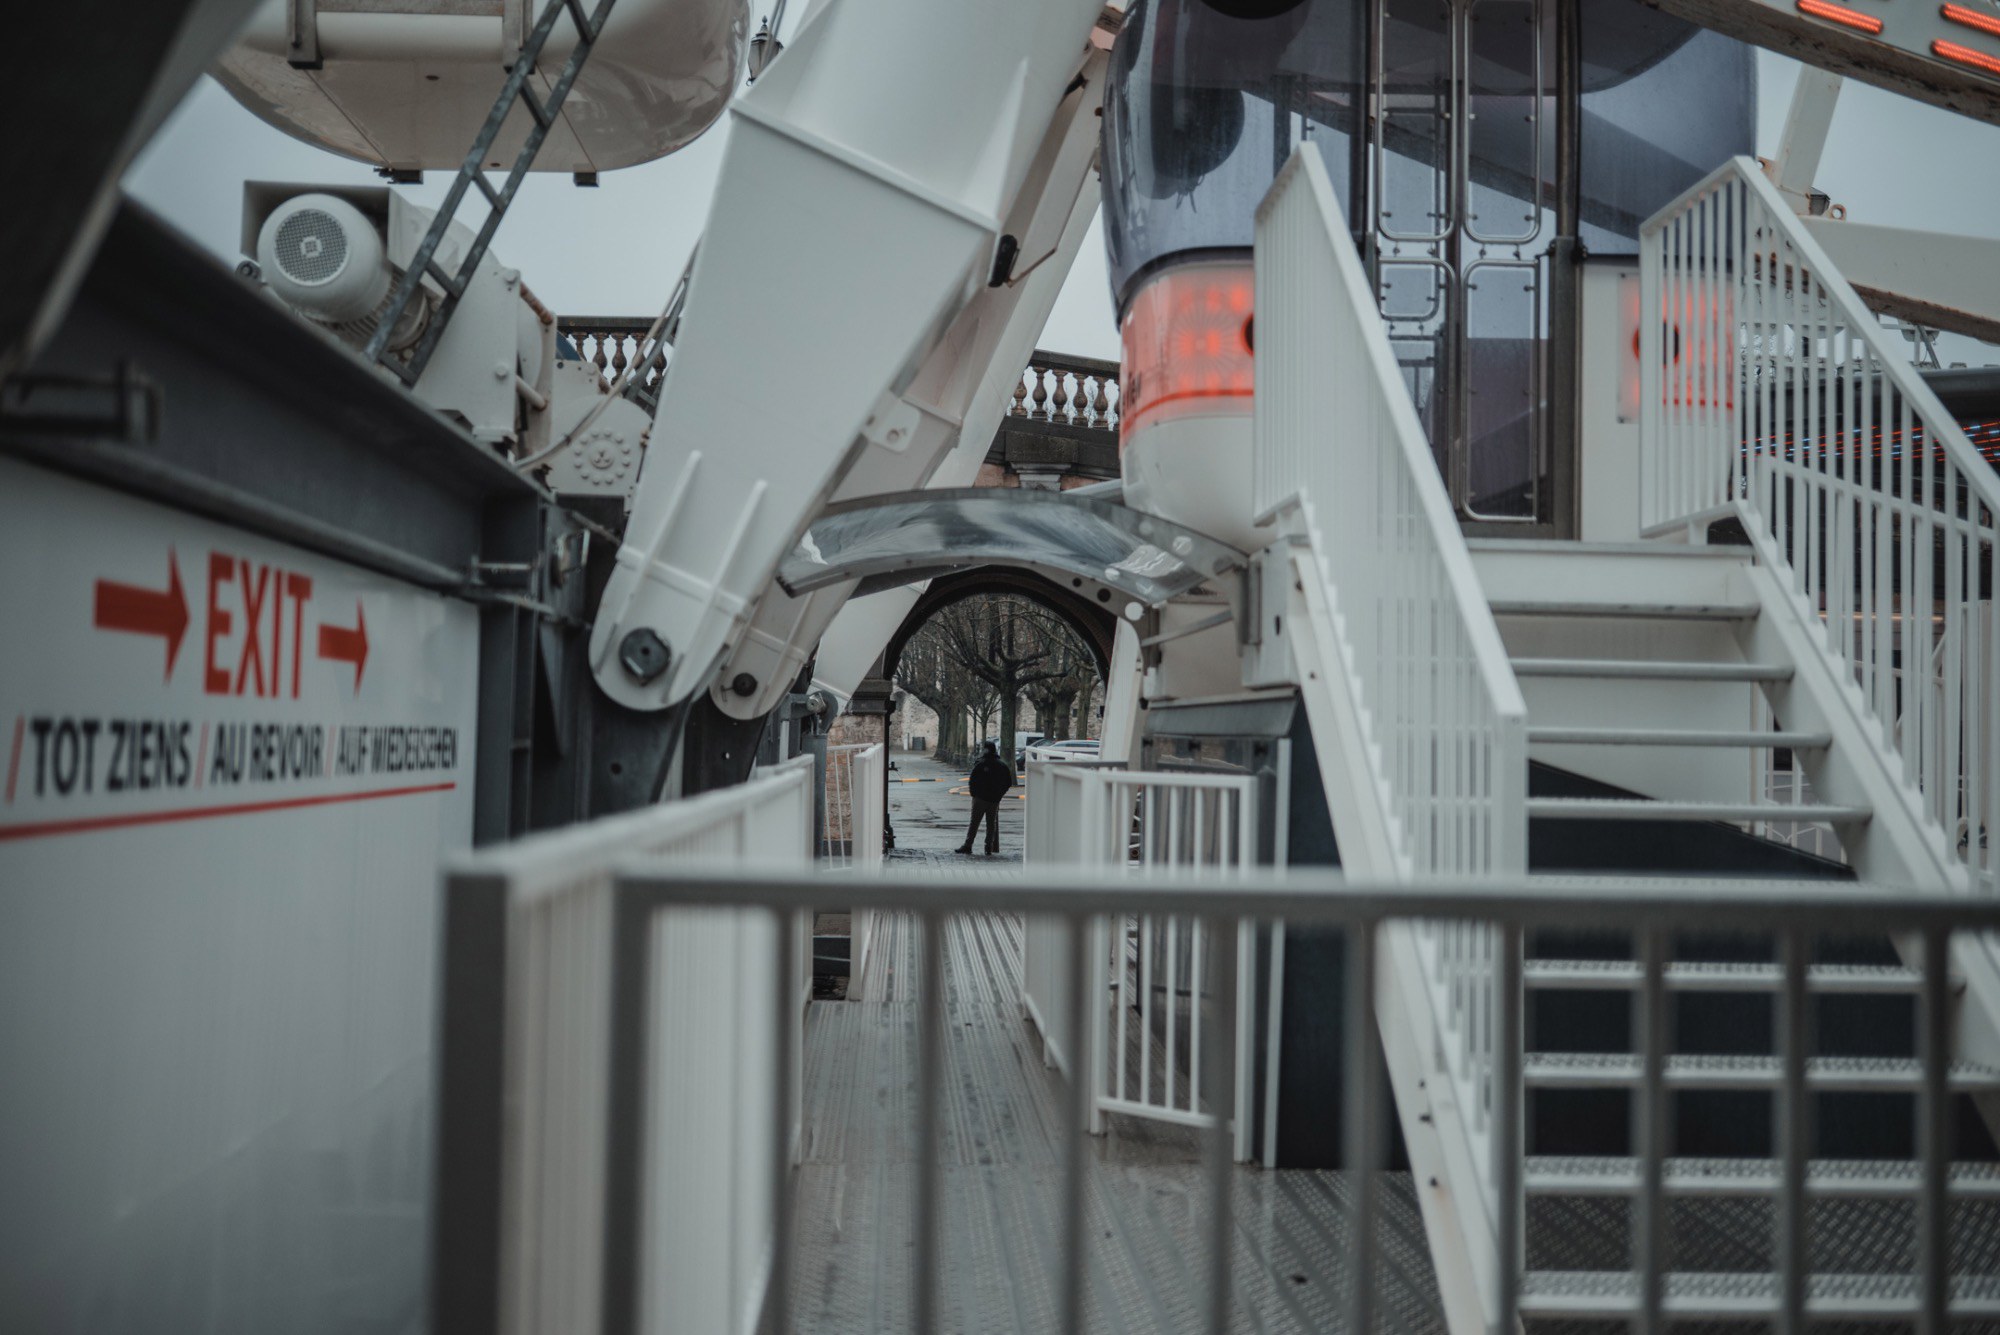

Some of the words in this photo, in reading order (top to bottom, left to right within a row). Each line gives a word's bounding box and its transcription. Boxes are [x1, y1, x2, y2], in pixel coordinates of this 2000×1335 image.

[205, 550, 312, 698] EXIT
[31, 718, 101, 797] TOT
[106, 720, 192, 790] ZIENS
[210, 723, 247, 784] AU
[249, 723, 324, 780] REVOIR
[336, 725, 369, 775] AUF
